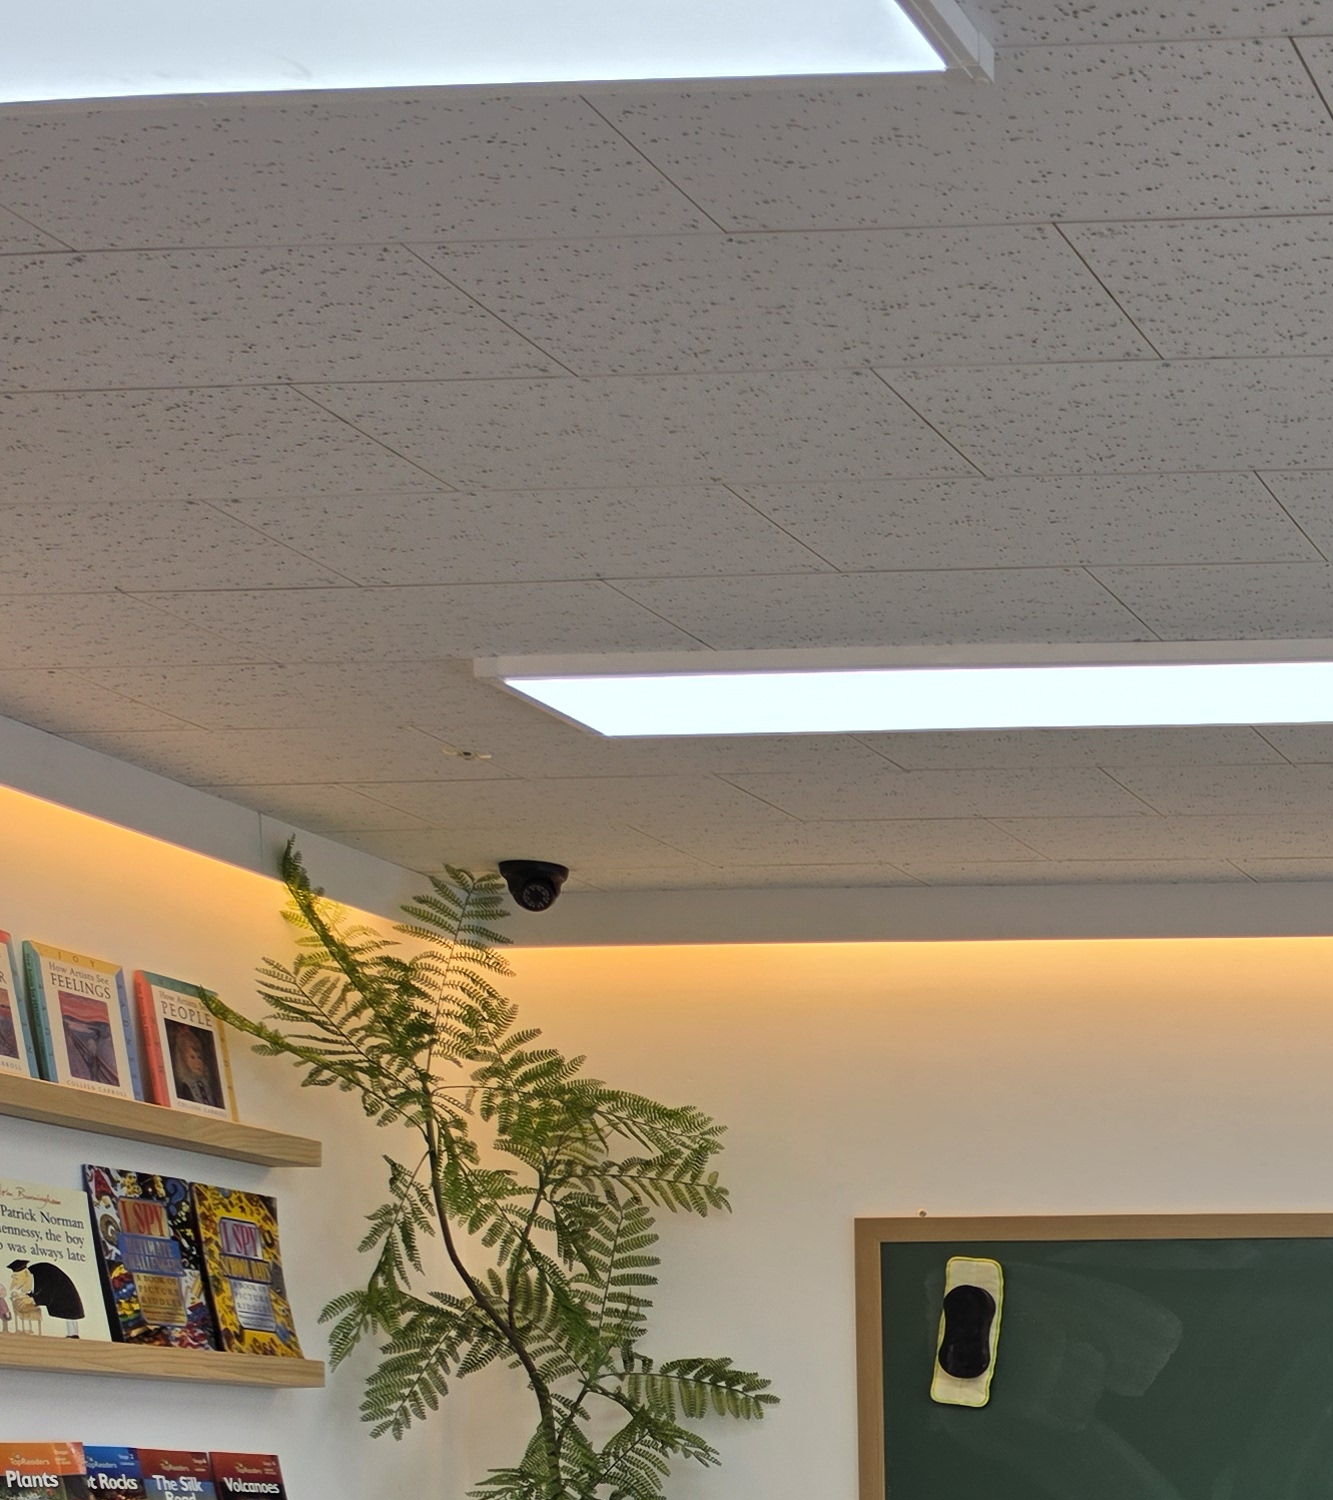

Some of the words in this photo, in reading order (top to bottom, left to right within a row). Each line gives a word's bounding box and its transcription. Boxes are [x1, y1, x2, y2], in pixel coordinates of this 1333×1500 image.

[49, 962, 67, 974] How
[69, 968, 95, 982] Artists
[96, 974, 110, 985] See
[51, 973, 112, 1000] FEELINGS
[160, 1000, 213, 1027] PEOPLE
[1, 1204, 37, 1222] Patrick
[40, 1210, 84, 1229] Norman
[131, 1202, 166, 1237] SPY
[45, 1229, 61, 1242] the
[65, 1231, 84, 1248] boy
[232, 1223, 260, 1257] SPY
[7, 1243, 27, 1254] was
[30, 1243, 64, 1261] always
[66, 1248, 86, 1262] late
[10, 1456, 50, 1467] TopReaders
[6, 1470, 59, 1488] Plants
[98, 1473, 138, 1490] Rocks
[152, 1475, 178, 1491] The
[180, 1476, 203, 1492] Silk
[223, 1477, 280, 1494] Volcanoes
